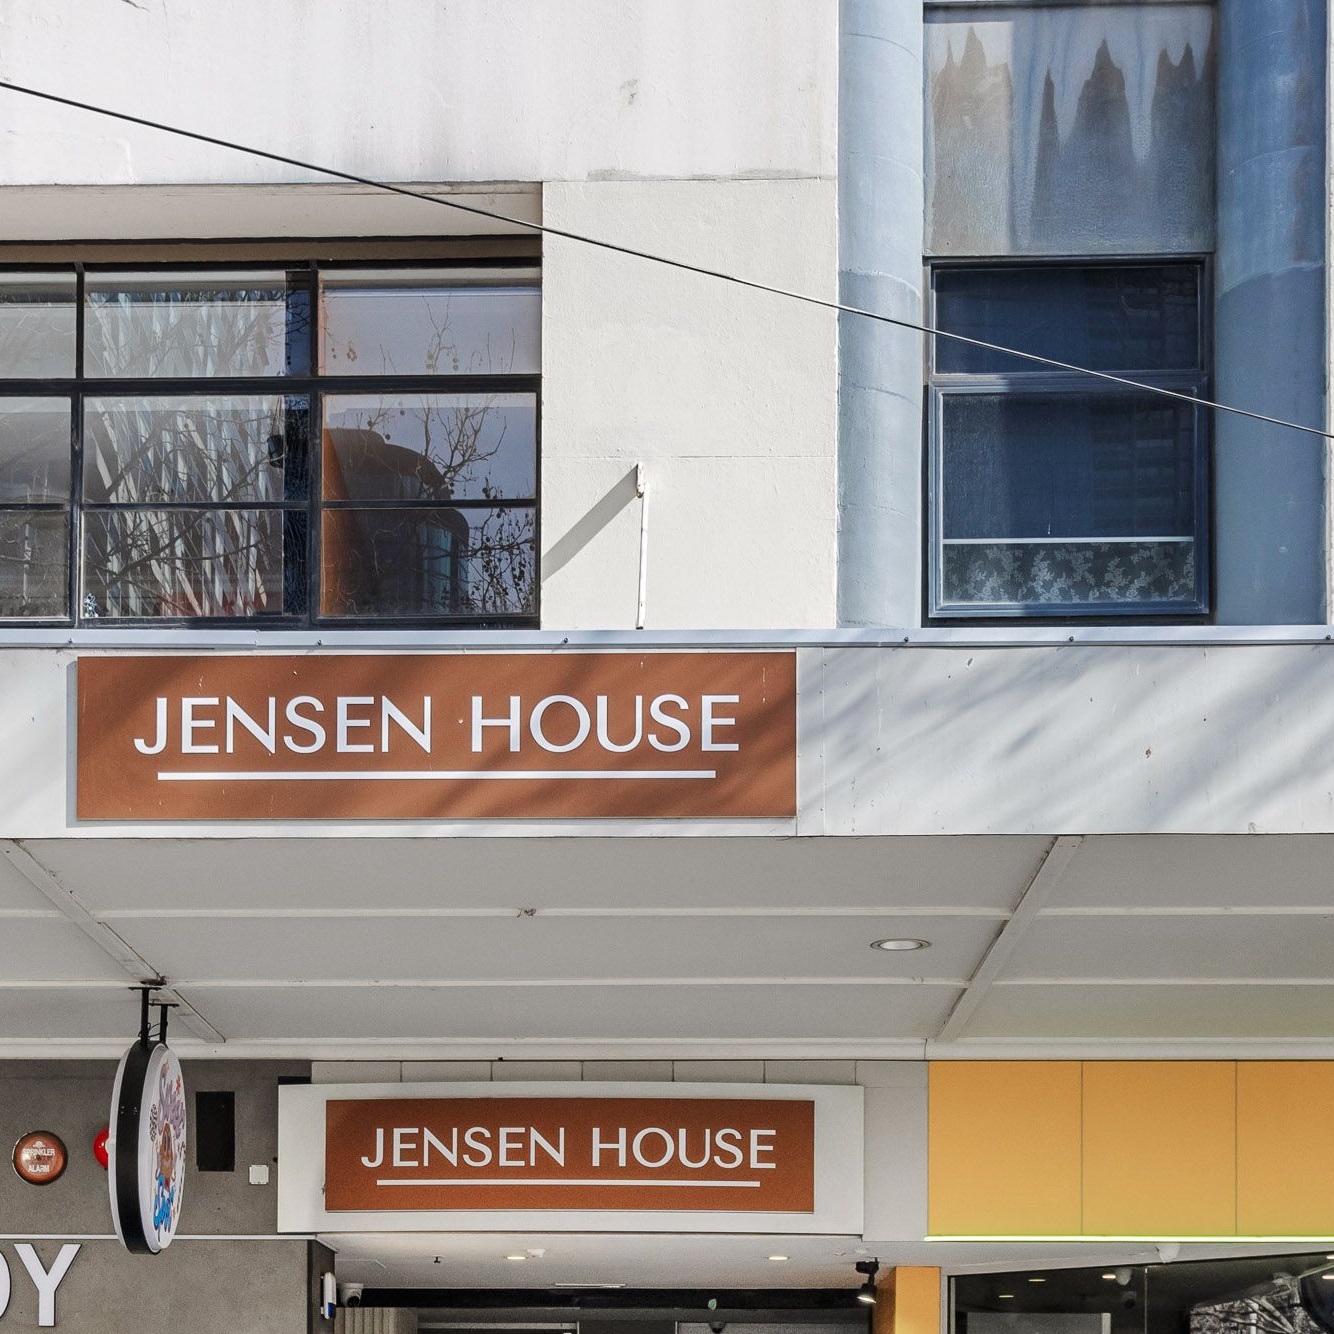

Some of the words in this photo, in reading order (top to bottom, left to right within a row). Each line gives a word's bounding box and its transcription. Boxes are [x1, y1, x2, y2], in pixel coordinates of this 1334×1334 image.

[133, 695, 432, 756] JENSEN
[471, 693, 740, 754] HOUSE
[22, 1148, 55, 1156] SPRINKLER
[360, 1126, 566, 1169] JENSEN
[591, 1126, 777, 1170] HOUSE
[27, 1164, 50, 1173] ALARM
